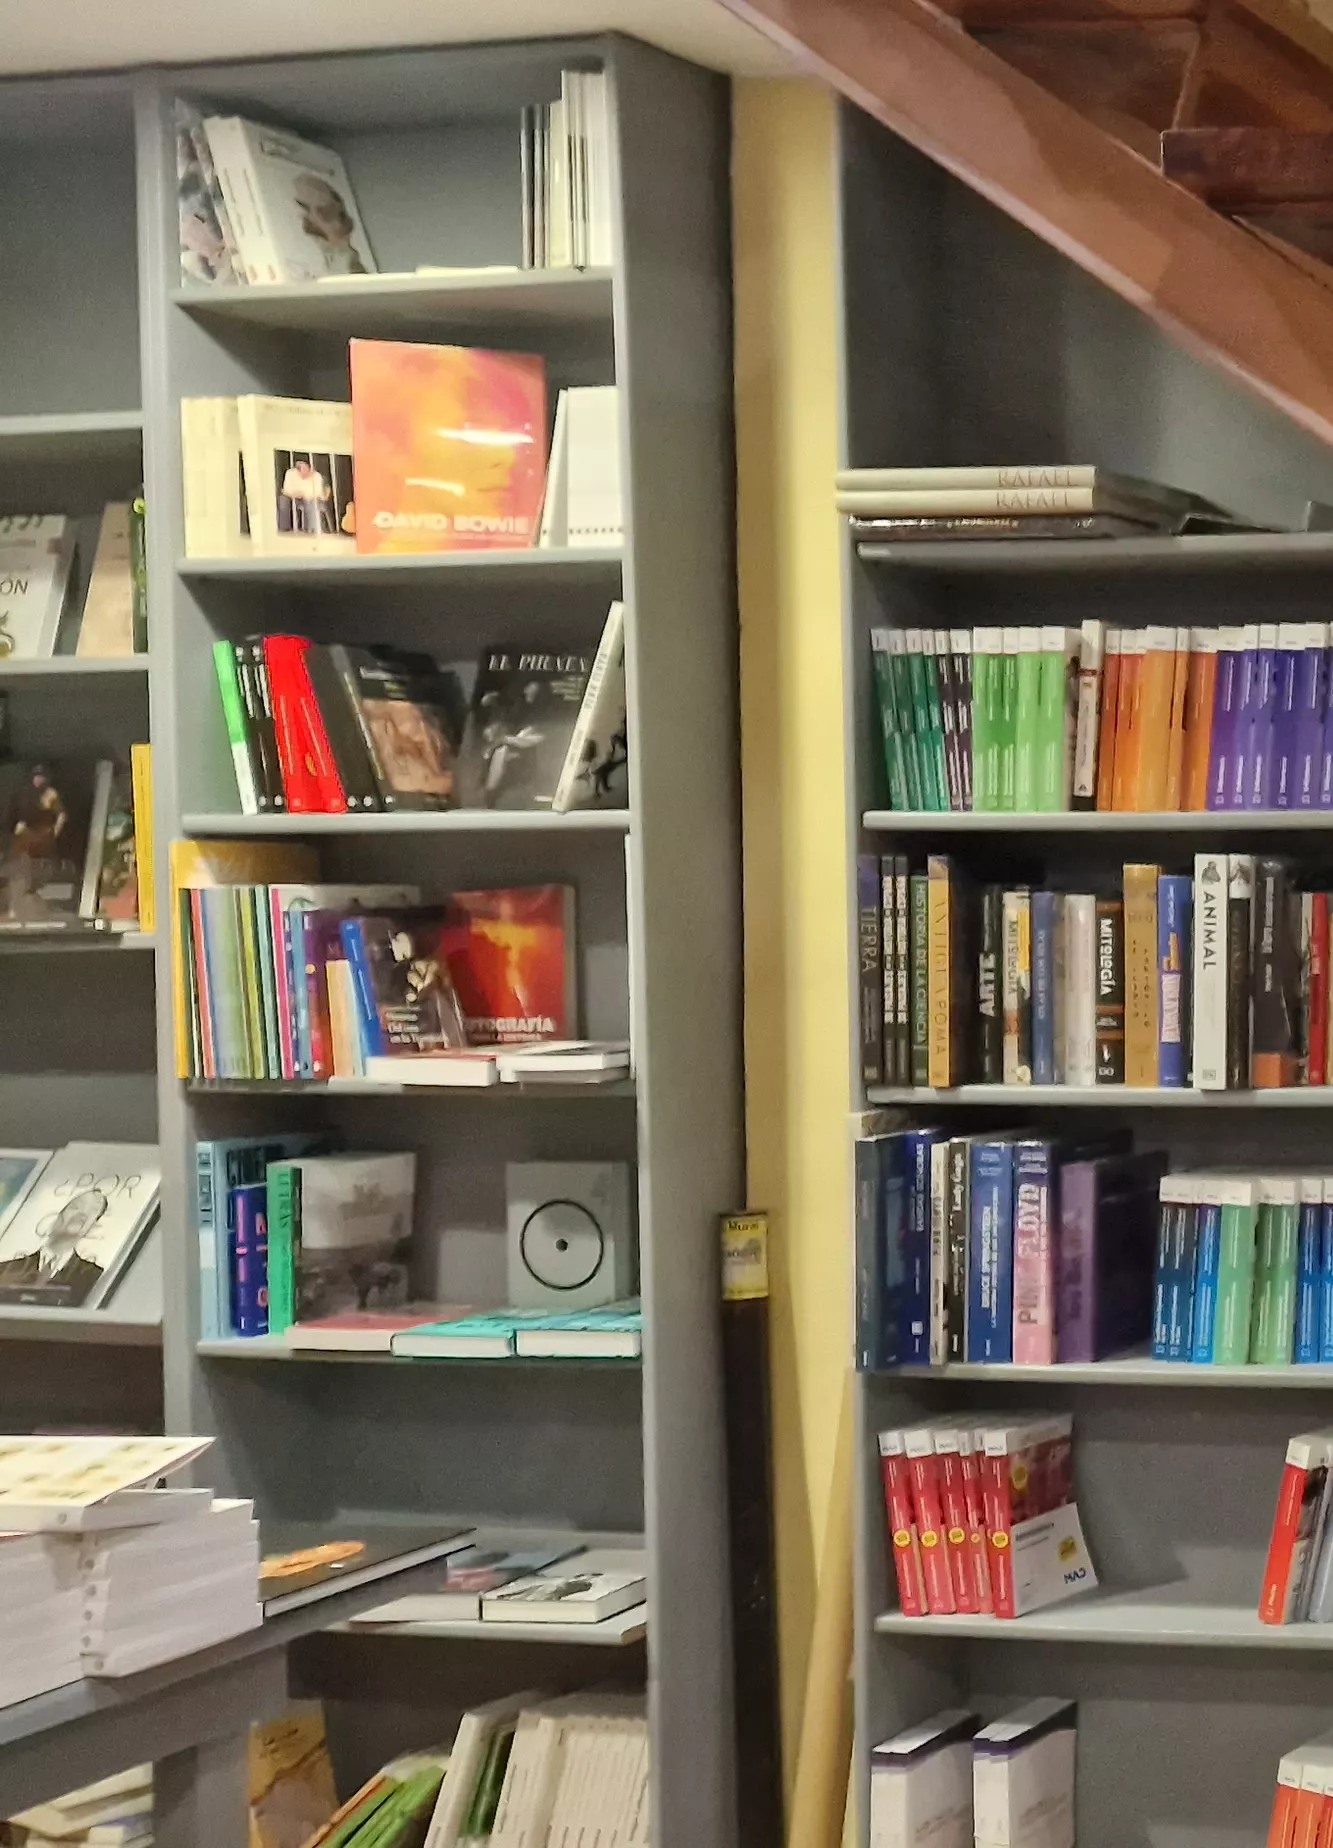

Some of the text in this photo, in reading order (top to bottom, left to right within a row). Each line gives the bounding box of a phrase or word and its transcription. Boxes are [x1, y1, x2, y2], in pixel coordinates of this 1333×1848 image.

[998, 469, 1079, 487] RAFAEL
[372, 511, 529, 533] DAVID BOWIE
[861, 905, 877, 972] TIERRA
[1100, 918, 1117, 996] MITOLOGÍA
[1203, 890, 1217, 971] ANIMAL
[915, 883, 926, 1043] HISTORIA DE LA CIENCIA
[979, 953, 996, 1017] ARTE
[464, 1015, 556, 1033] OTOGRAFÍA
[934, 1000, 948, 1055] ROMA
[1018, 1183, 1040, 1259] FLOYD
[1018, 1273, 1038, 1325] PIN
